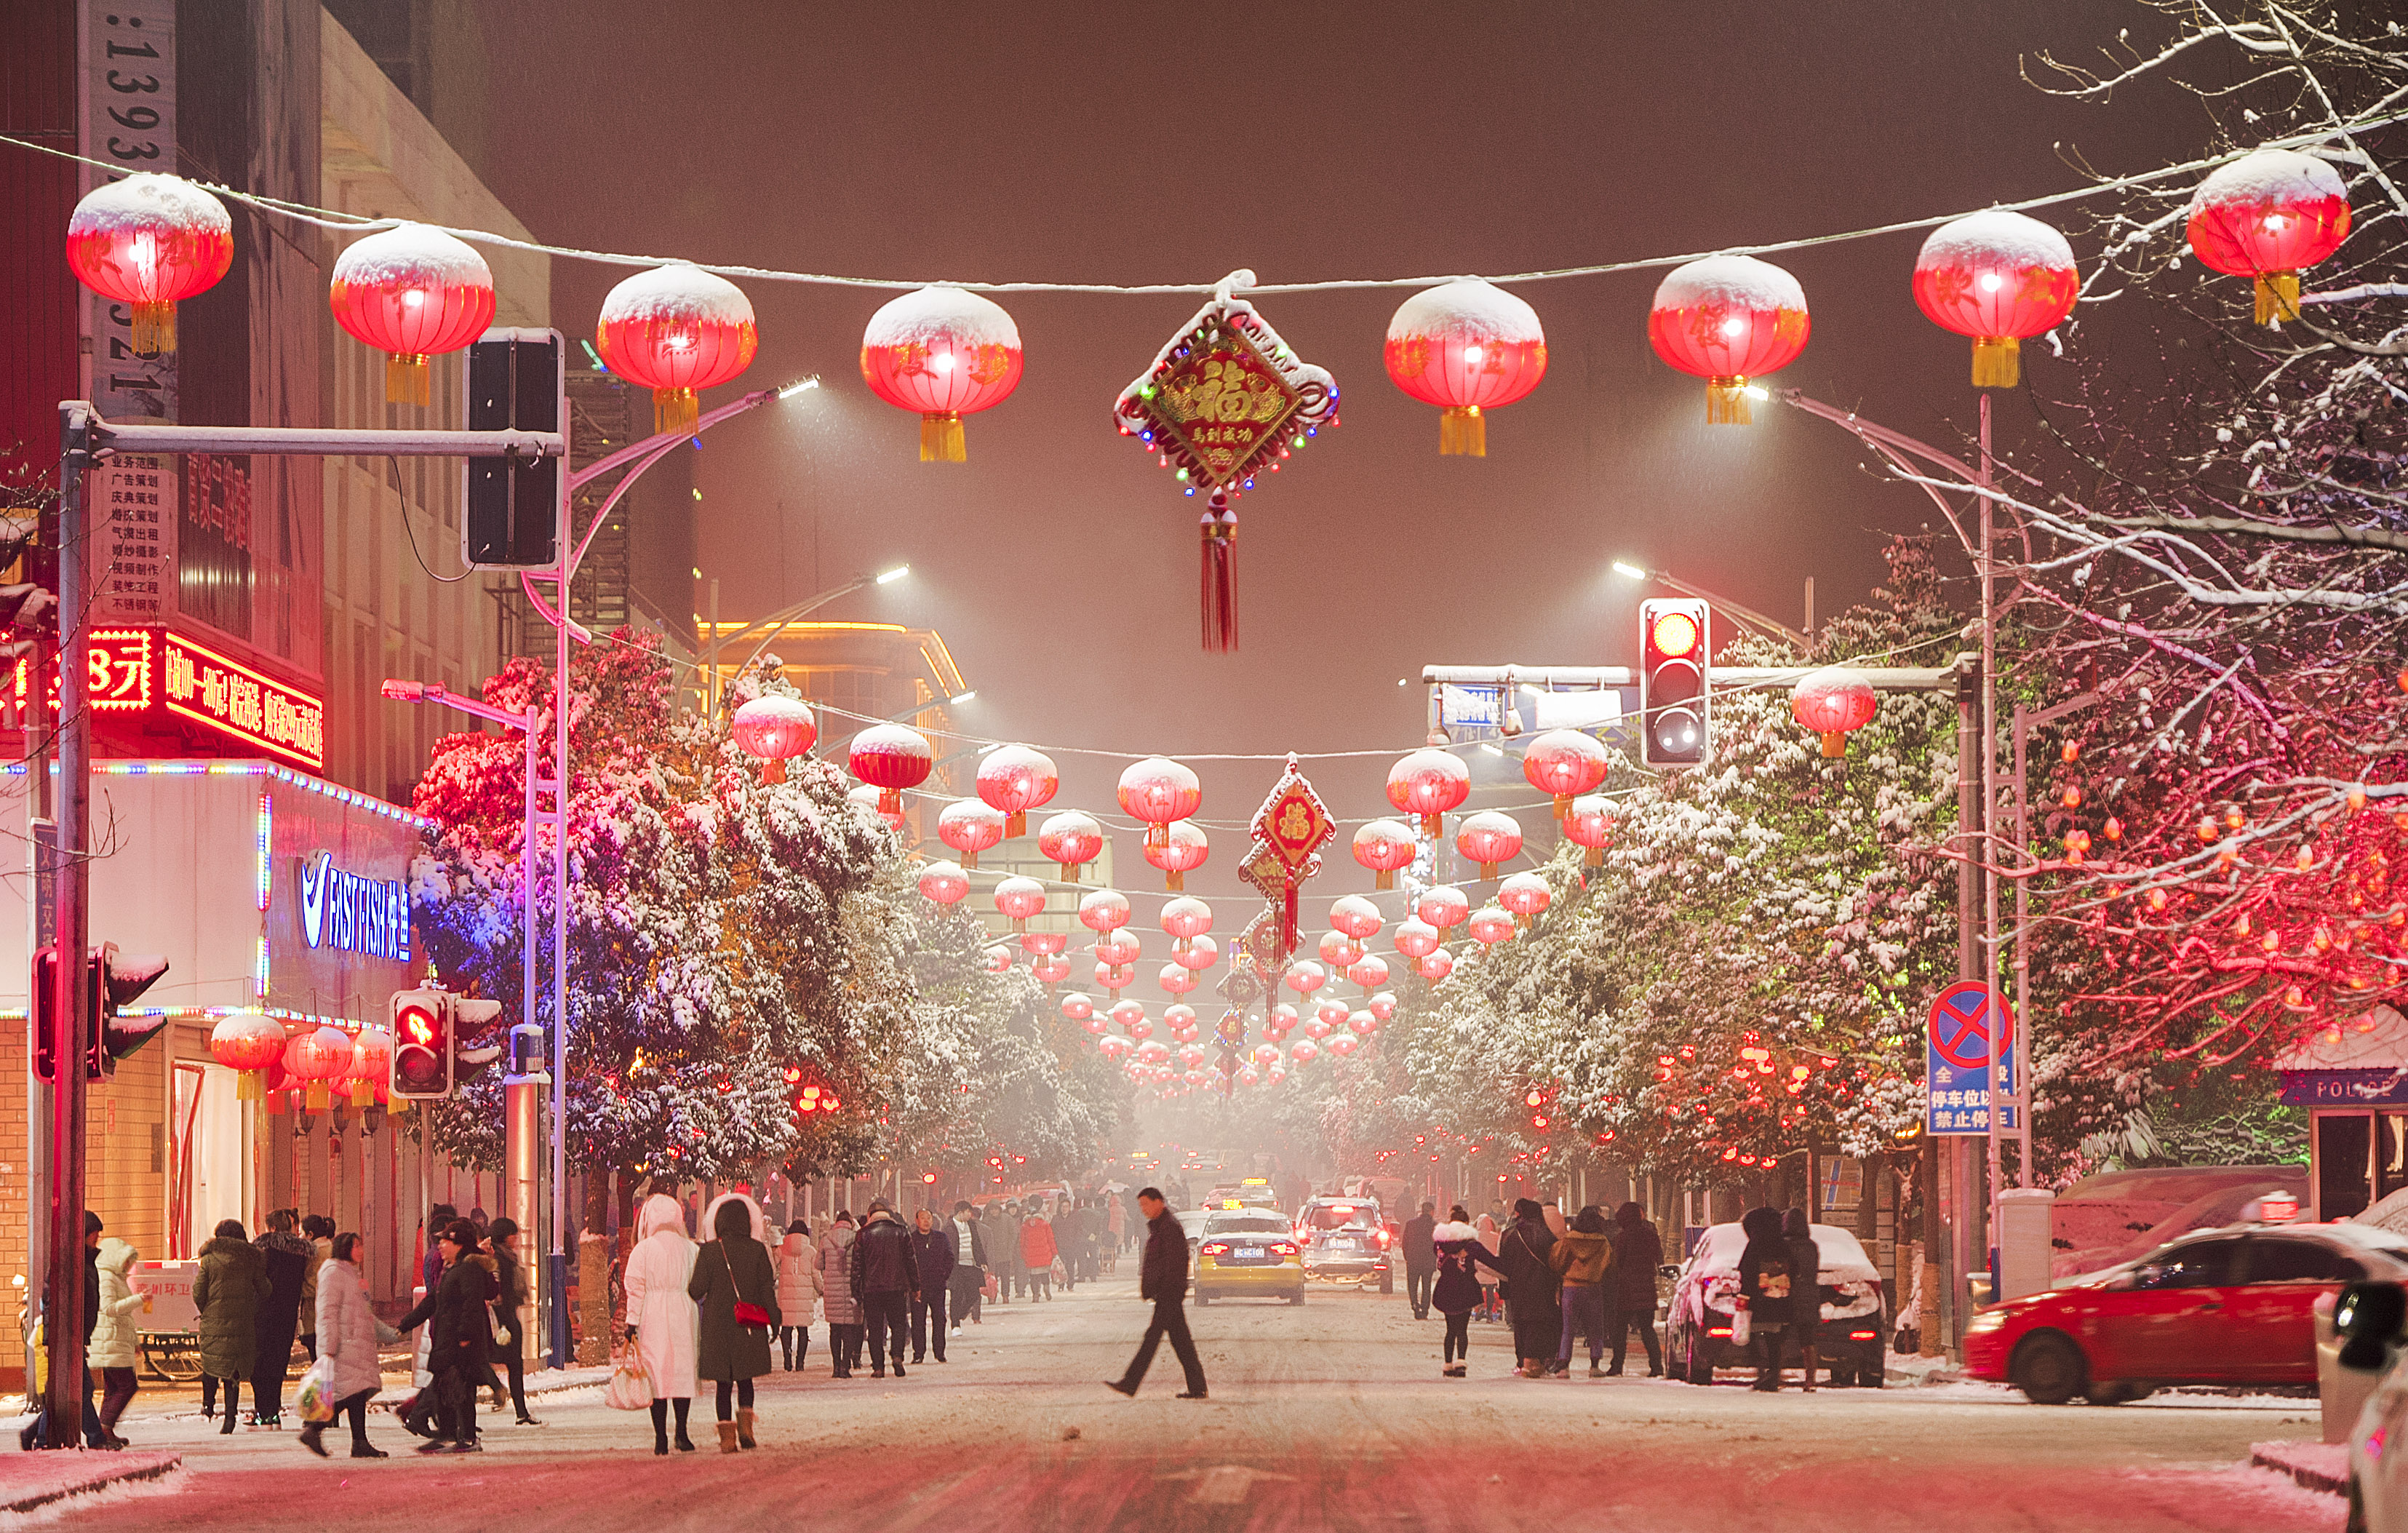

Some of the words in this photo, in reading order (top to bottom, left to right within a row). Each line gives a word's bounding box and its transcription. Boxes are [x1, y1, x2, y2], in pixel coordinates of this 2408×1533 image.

[1192, 359, 1252, 423] 福
[111, 473, 158, 487] 广告策划
[111, 490, 158, 505] 庆典策划
[112, 562, 159, 576] 视频制作
[1931, 1089, 2009, 1108] 停车位以
